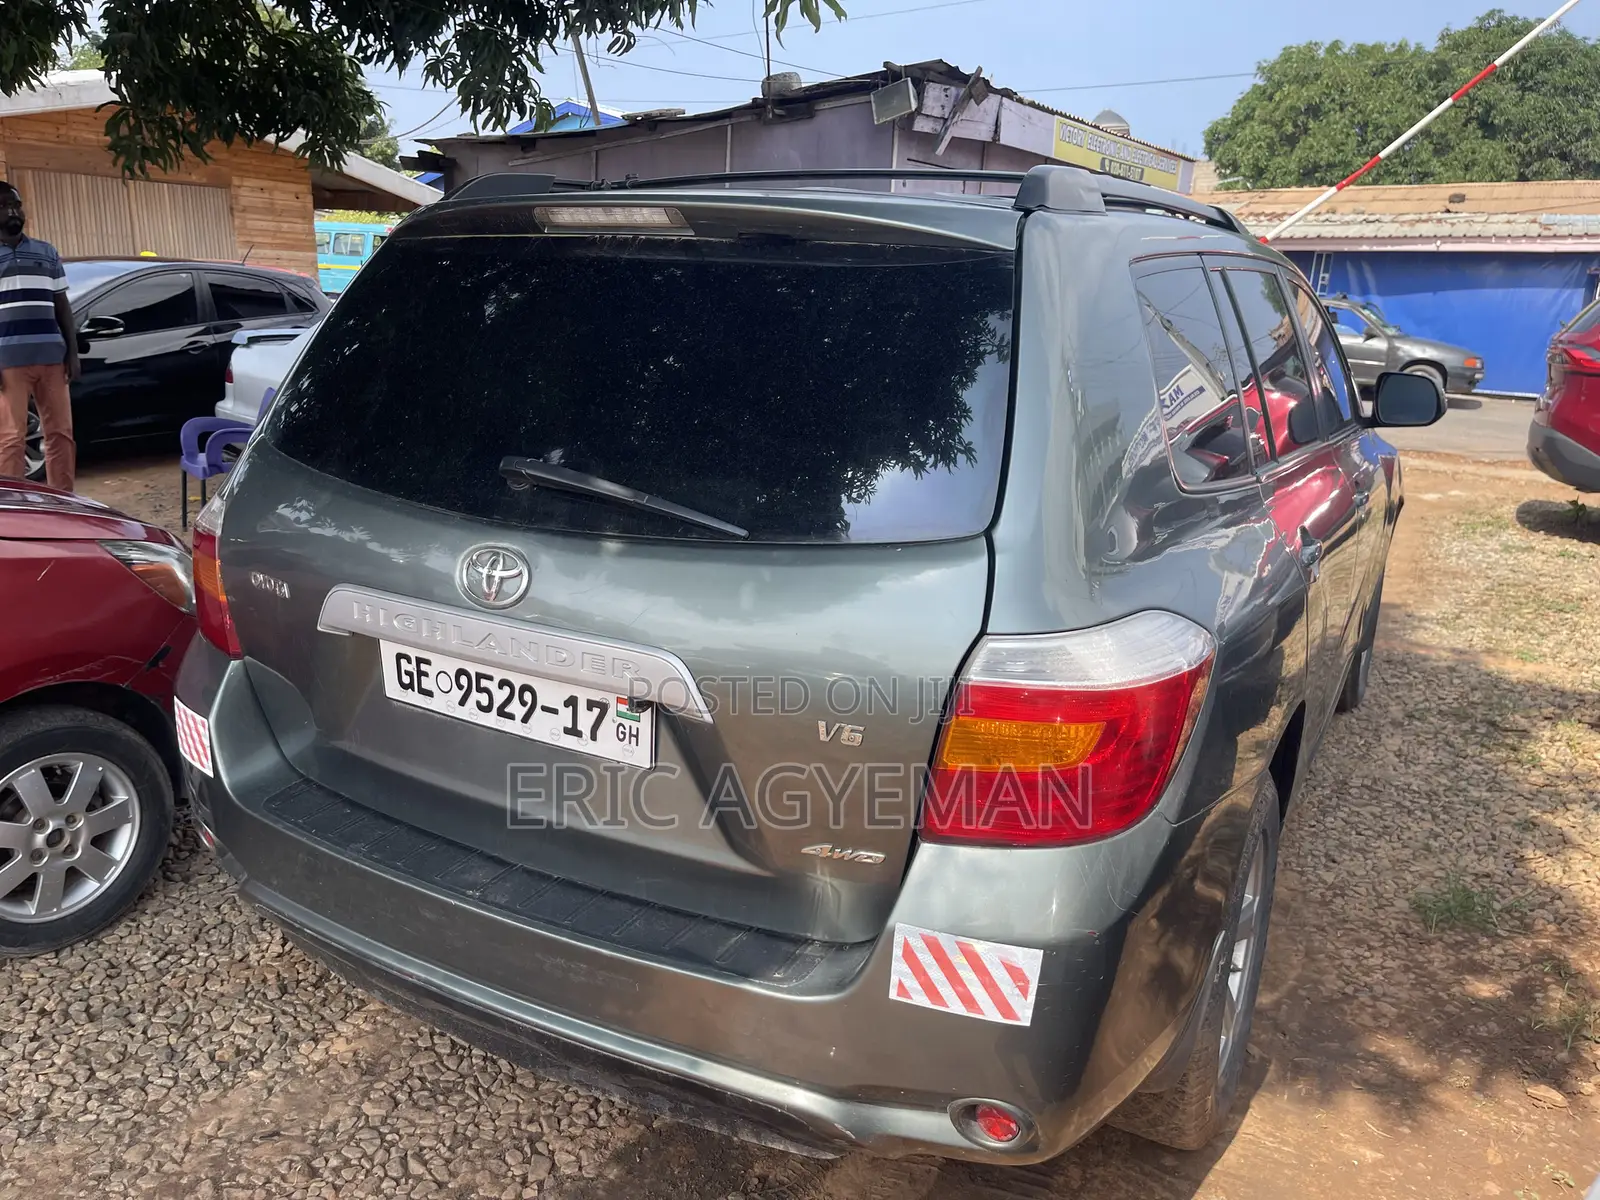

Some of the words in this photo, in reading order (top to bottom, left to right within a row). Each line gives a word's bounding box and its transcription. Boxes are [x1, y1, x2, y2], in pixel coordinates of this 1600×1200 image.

[1059, 122, 1086, 147] VICTORY
[352, 600, 643, 681] HIGHLANDER
[395, 652, 434, 698] GE
[453, 668, 610, 742] 9529-17
[615, 722, 639, 747] GH
[817, 720, 866, 747] V6
[801, 843, 885, 864] 4WD
